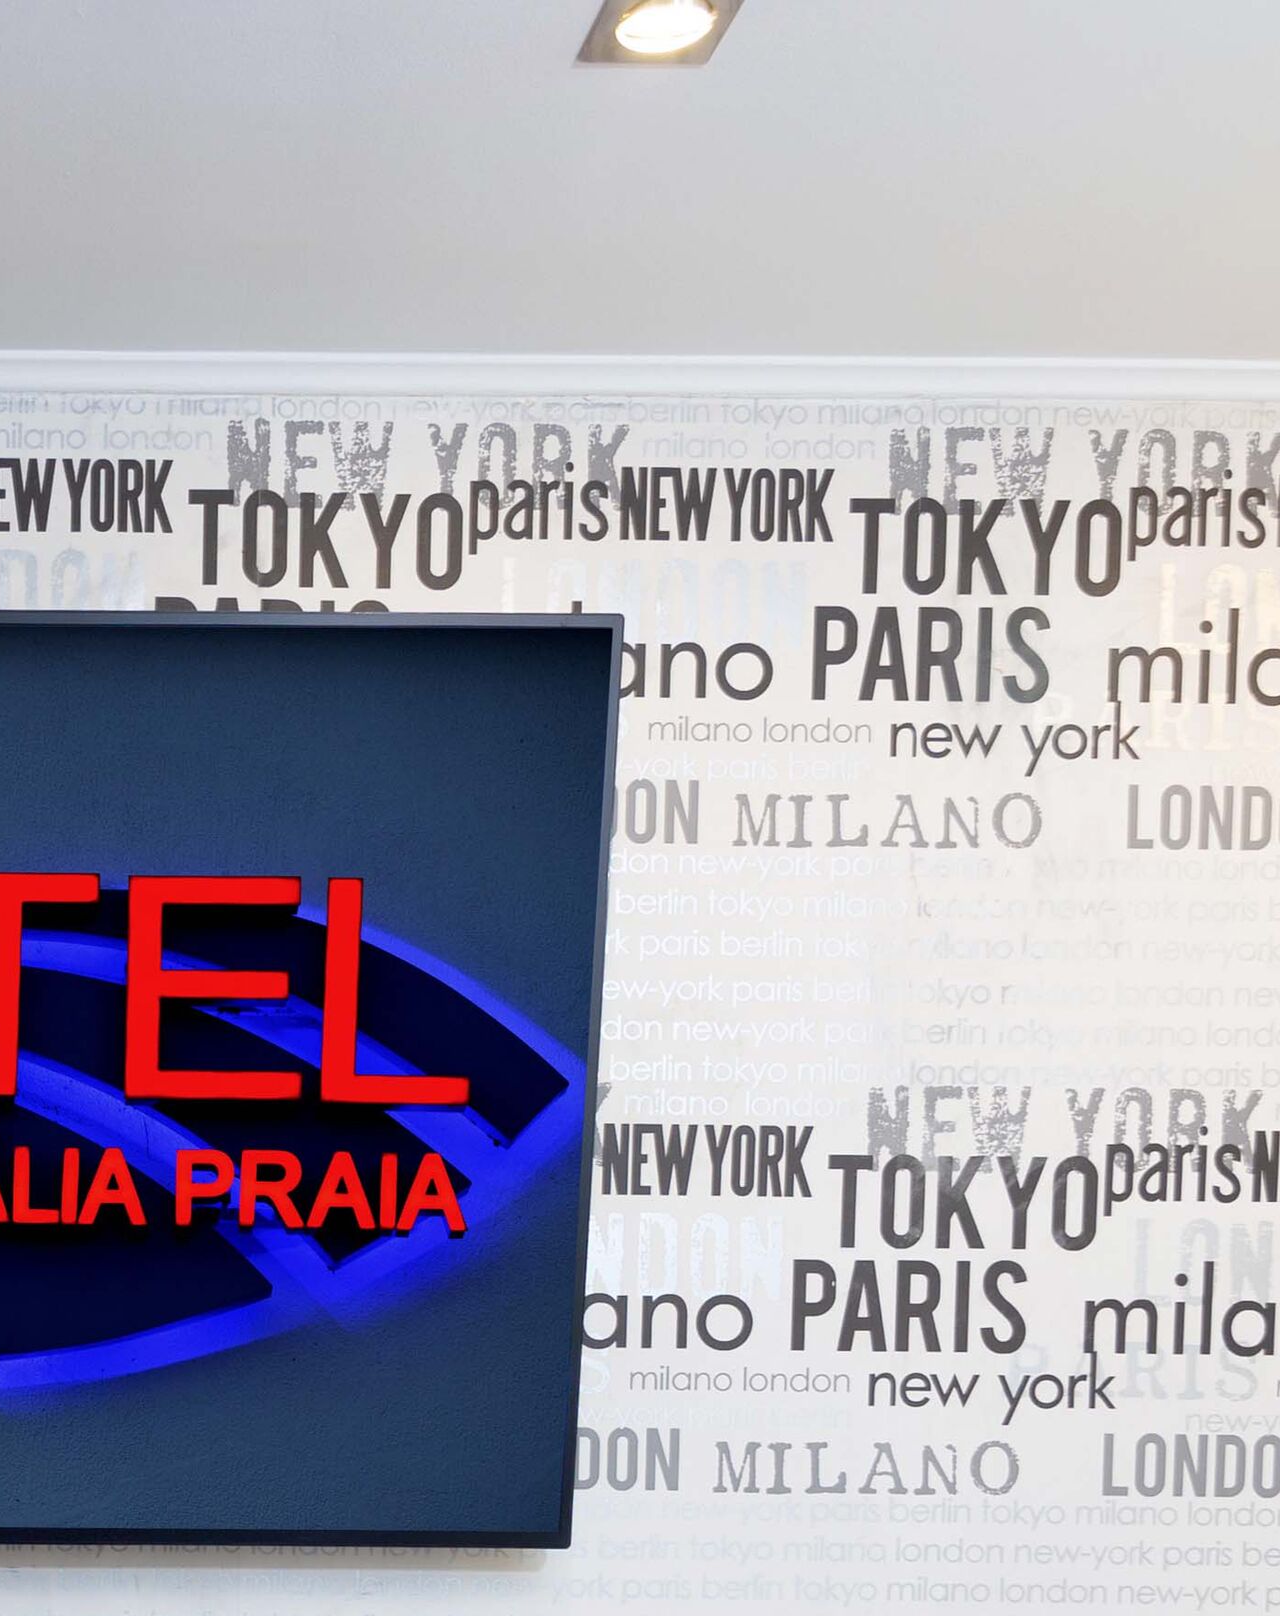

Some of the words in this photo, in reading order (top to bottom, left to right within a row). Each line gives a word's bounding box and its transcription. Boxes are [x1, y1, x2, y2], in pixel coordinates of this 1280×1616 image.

[103, 426, 212, 452] london
[63, 458, 173, 533] YORK
[469, 462, 609, 556] paris
[620, 466, 717, 542] NEW
[724, 468, 835, 543] YORK
[1129, 469, 1266, 561] paris
[188, 489, 463, 591] TOKYO
[850, 498, 1122, 597] TOKYO
[811, 606, 1051, 703] PARIS
[648, 717, 751, 742] milano
[763, 717, 871, 743] london
[890, 721, 1002, 757] new
[1022, 701, 1140, 777] york
[735, 791, 1043, 848] MILANO
[173, 1144, 467, 1236] PRAIA
[602, 1123, 697, 1195] NEW
[705, 1125, 813, 1198] YORK
[1104, 1126, 1239, 1216] paris
[829, 1154, 1098, 1252] TOKYO
[791, 1260, 1028, 1354] PARIS
[629, 1367, 732, 1392] milano
[743, 1368, 850, 1392] london
[868, 1370, 979, 1407] new
[999, 1350, 1116, 1424] york
[713, 1440, 1020, 1496] MILANO
[895, 1537, 1004, 1565] london
[1014, 1538, 1152, 1572] new-york
[1163, 1541, 1233, 1572] paris
